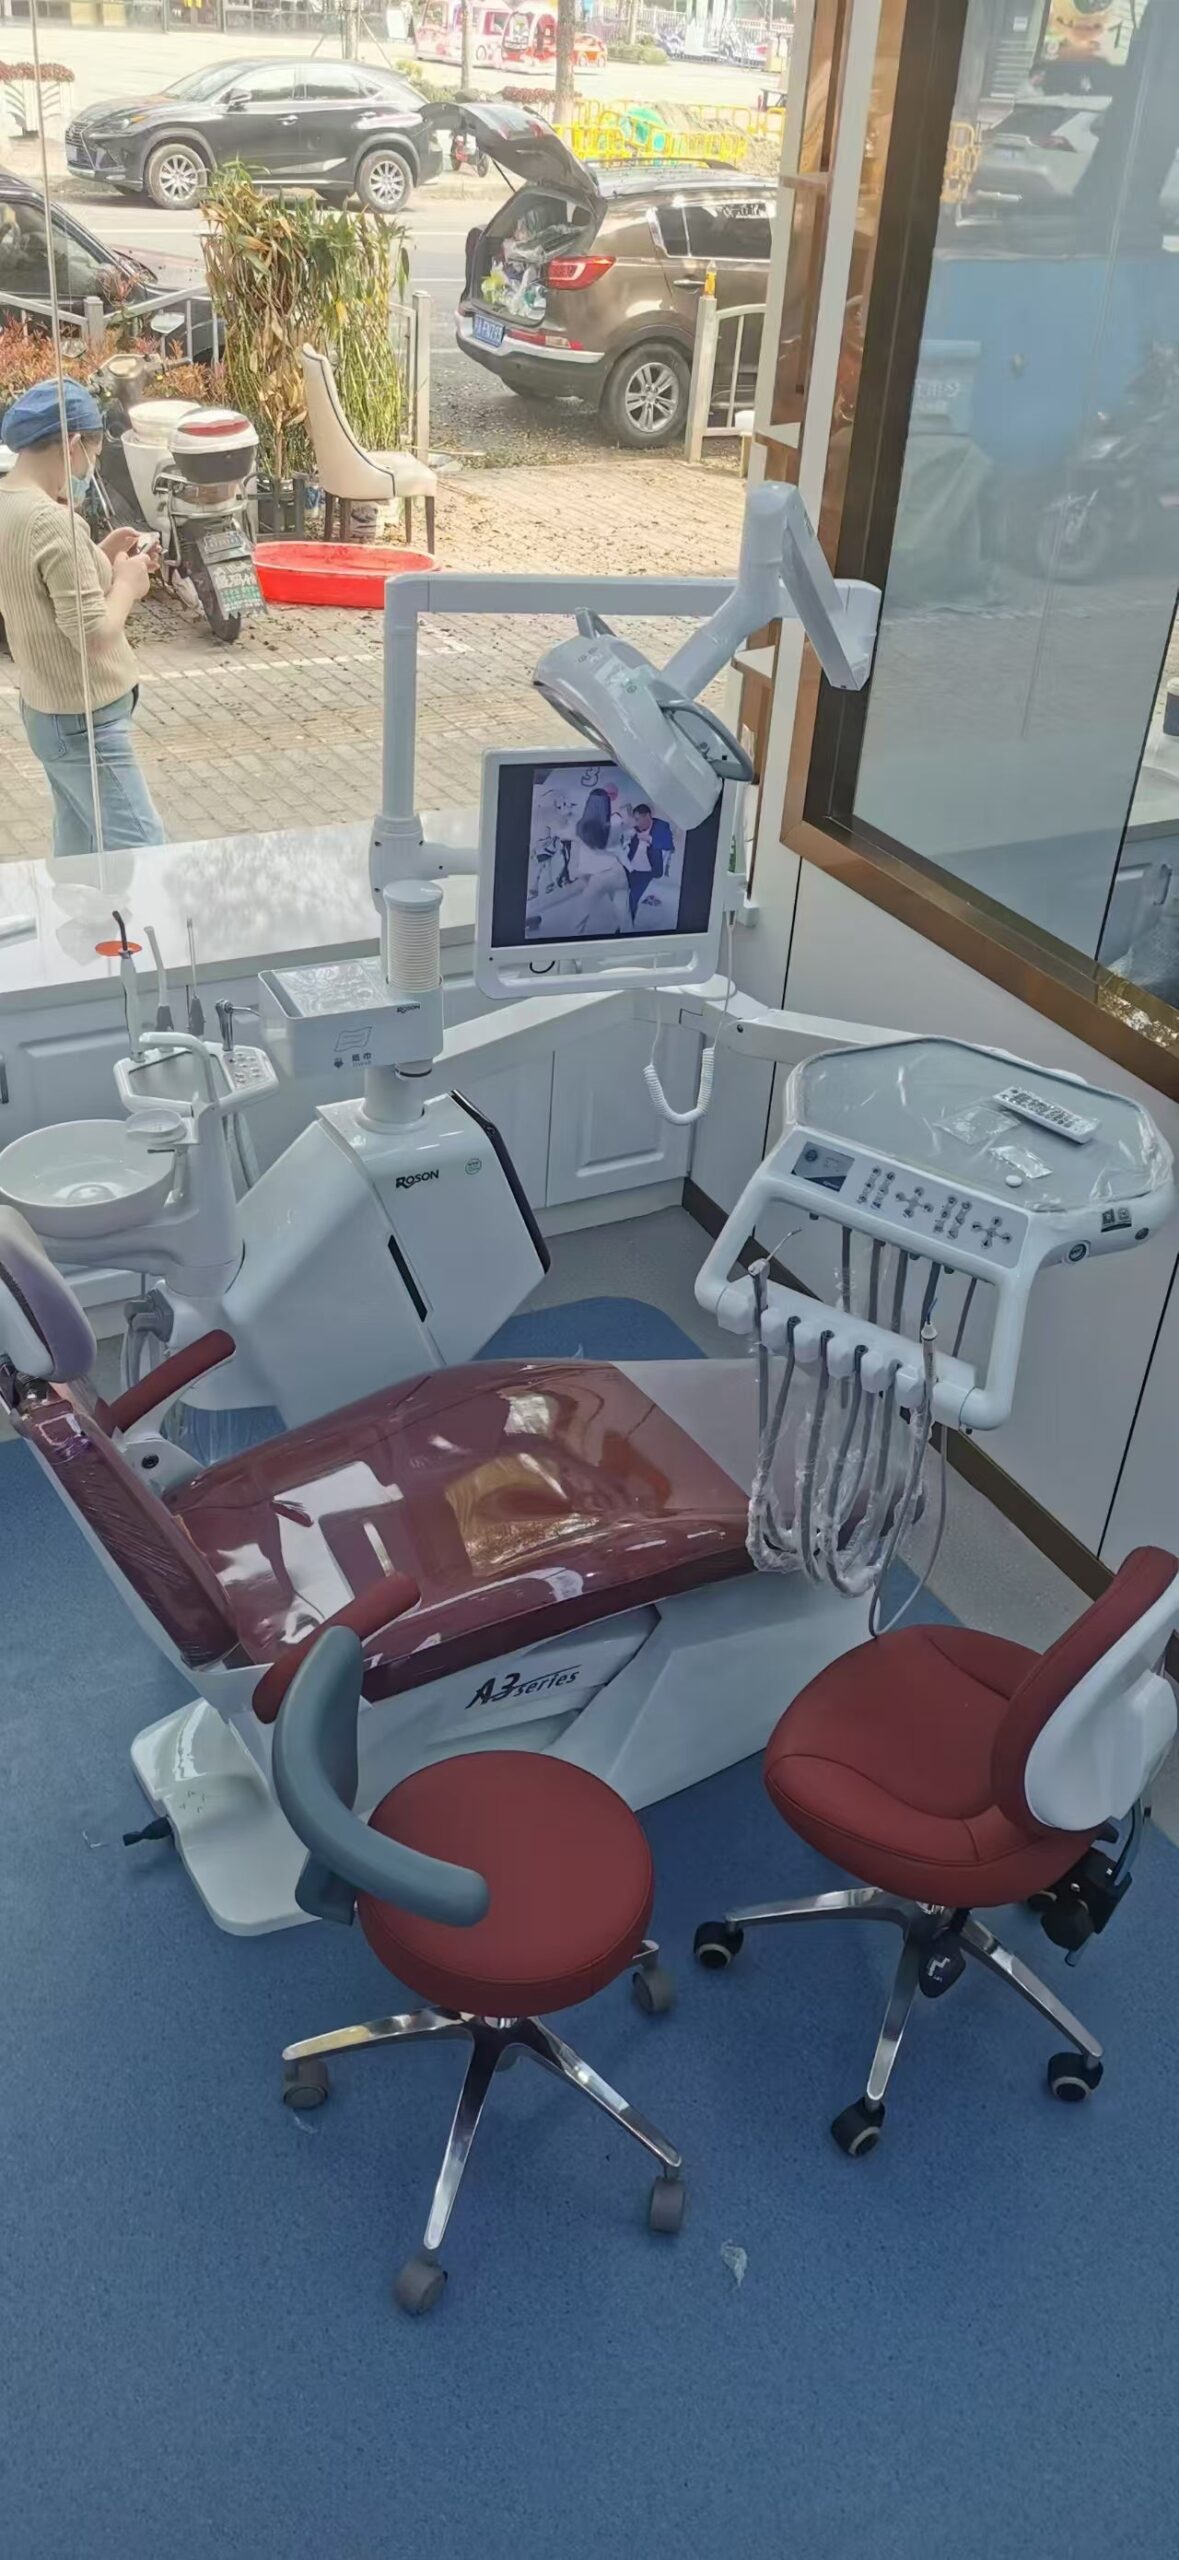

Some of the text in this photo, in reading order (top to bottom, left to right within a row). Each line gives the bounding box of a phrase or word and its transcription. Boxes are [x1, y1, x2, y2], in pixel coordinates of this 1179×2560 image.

[395, 1169, 440, 1189] ROSON
[464, 1671, 580, 1710] A3 series
